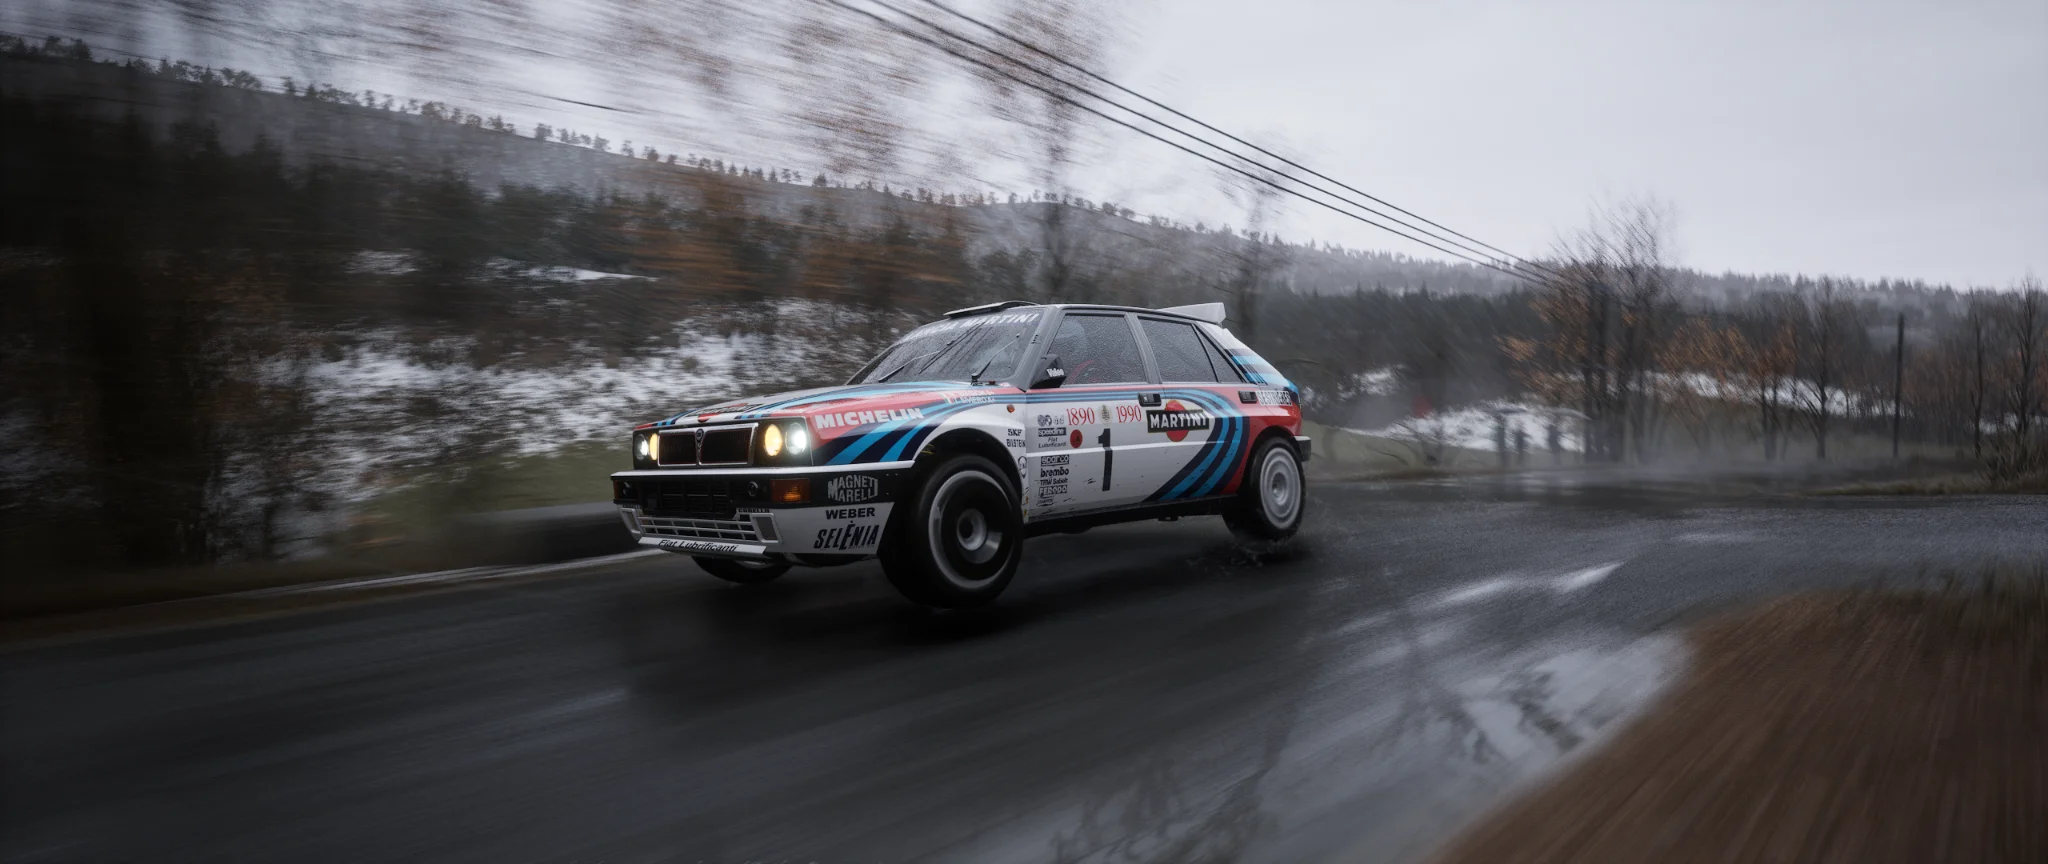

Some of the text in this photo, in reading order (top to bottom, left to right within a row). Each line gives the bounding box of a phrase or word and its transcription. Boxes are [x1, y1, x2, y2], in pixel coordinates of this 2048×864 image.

[960, 313, 1039, 328] MARTINI
[814, 407, 925, 429] MICHELIN
[1066, 407, 1095, 426] 1890
[1116, 405, 1142, 423] 1990
[1149, 412, 1207, 429] MARTINI
[1006, 439, 1026, 447] BILSTEIN
[1098, 428, 1113, 491] 1
[1040, 466, 1069, 478] brembo
[825, 507, 876, 520] WEBER
[658, 539, 739, 552] Fiat Lubrificanti
